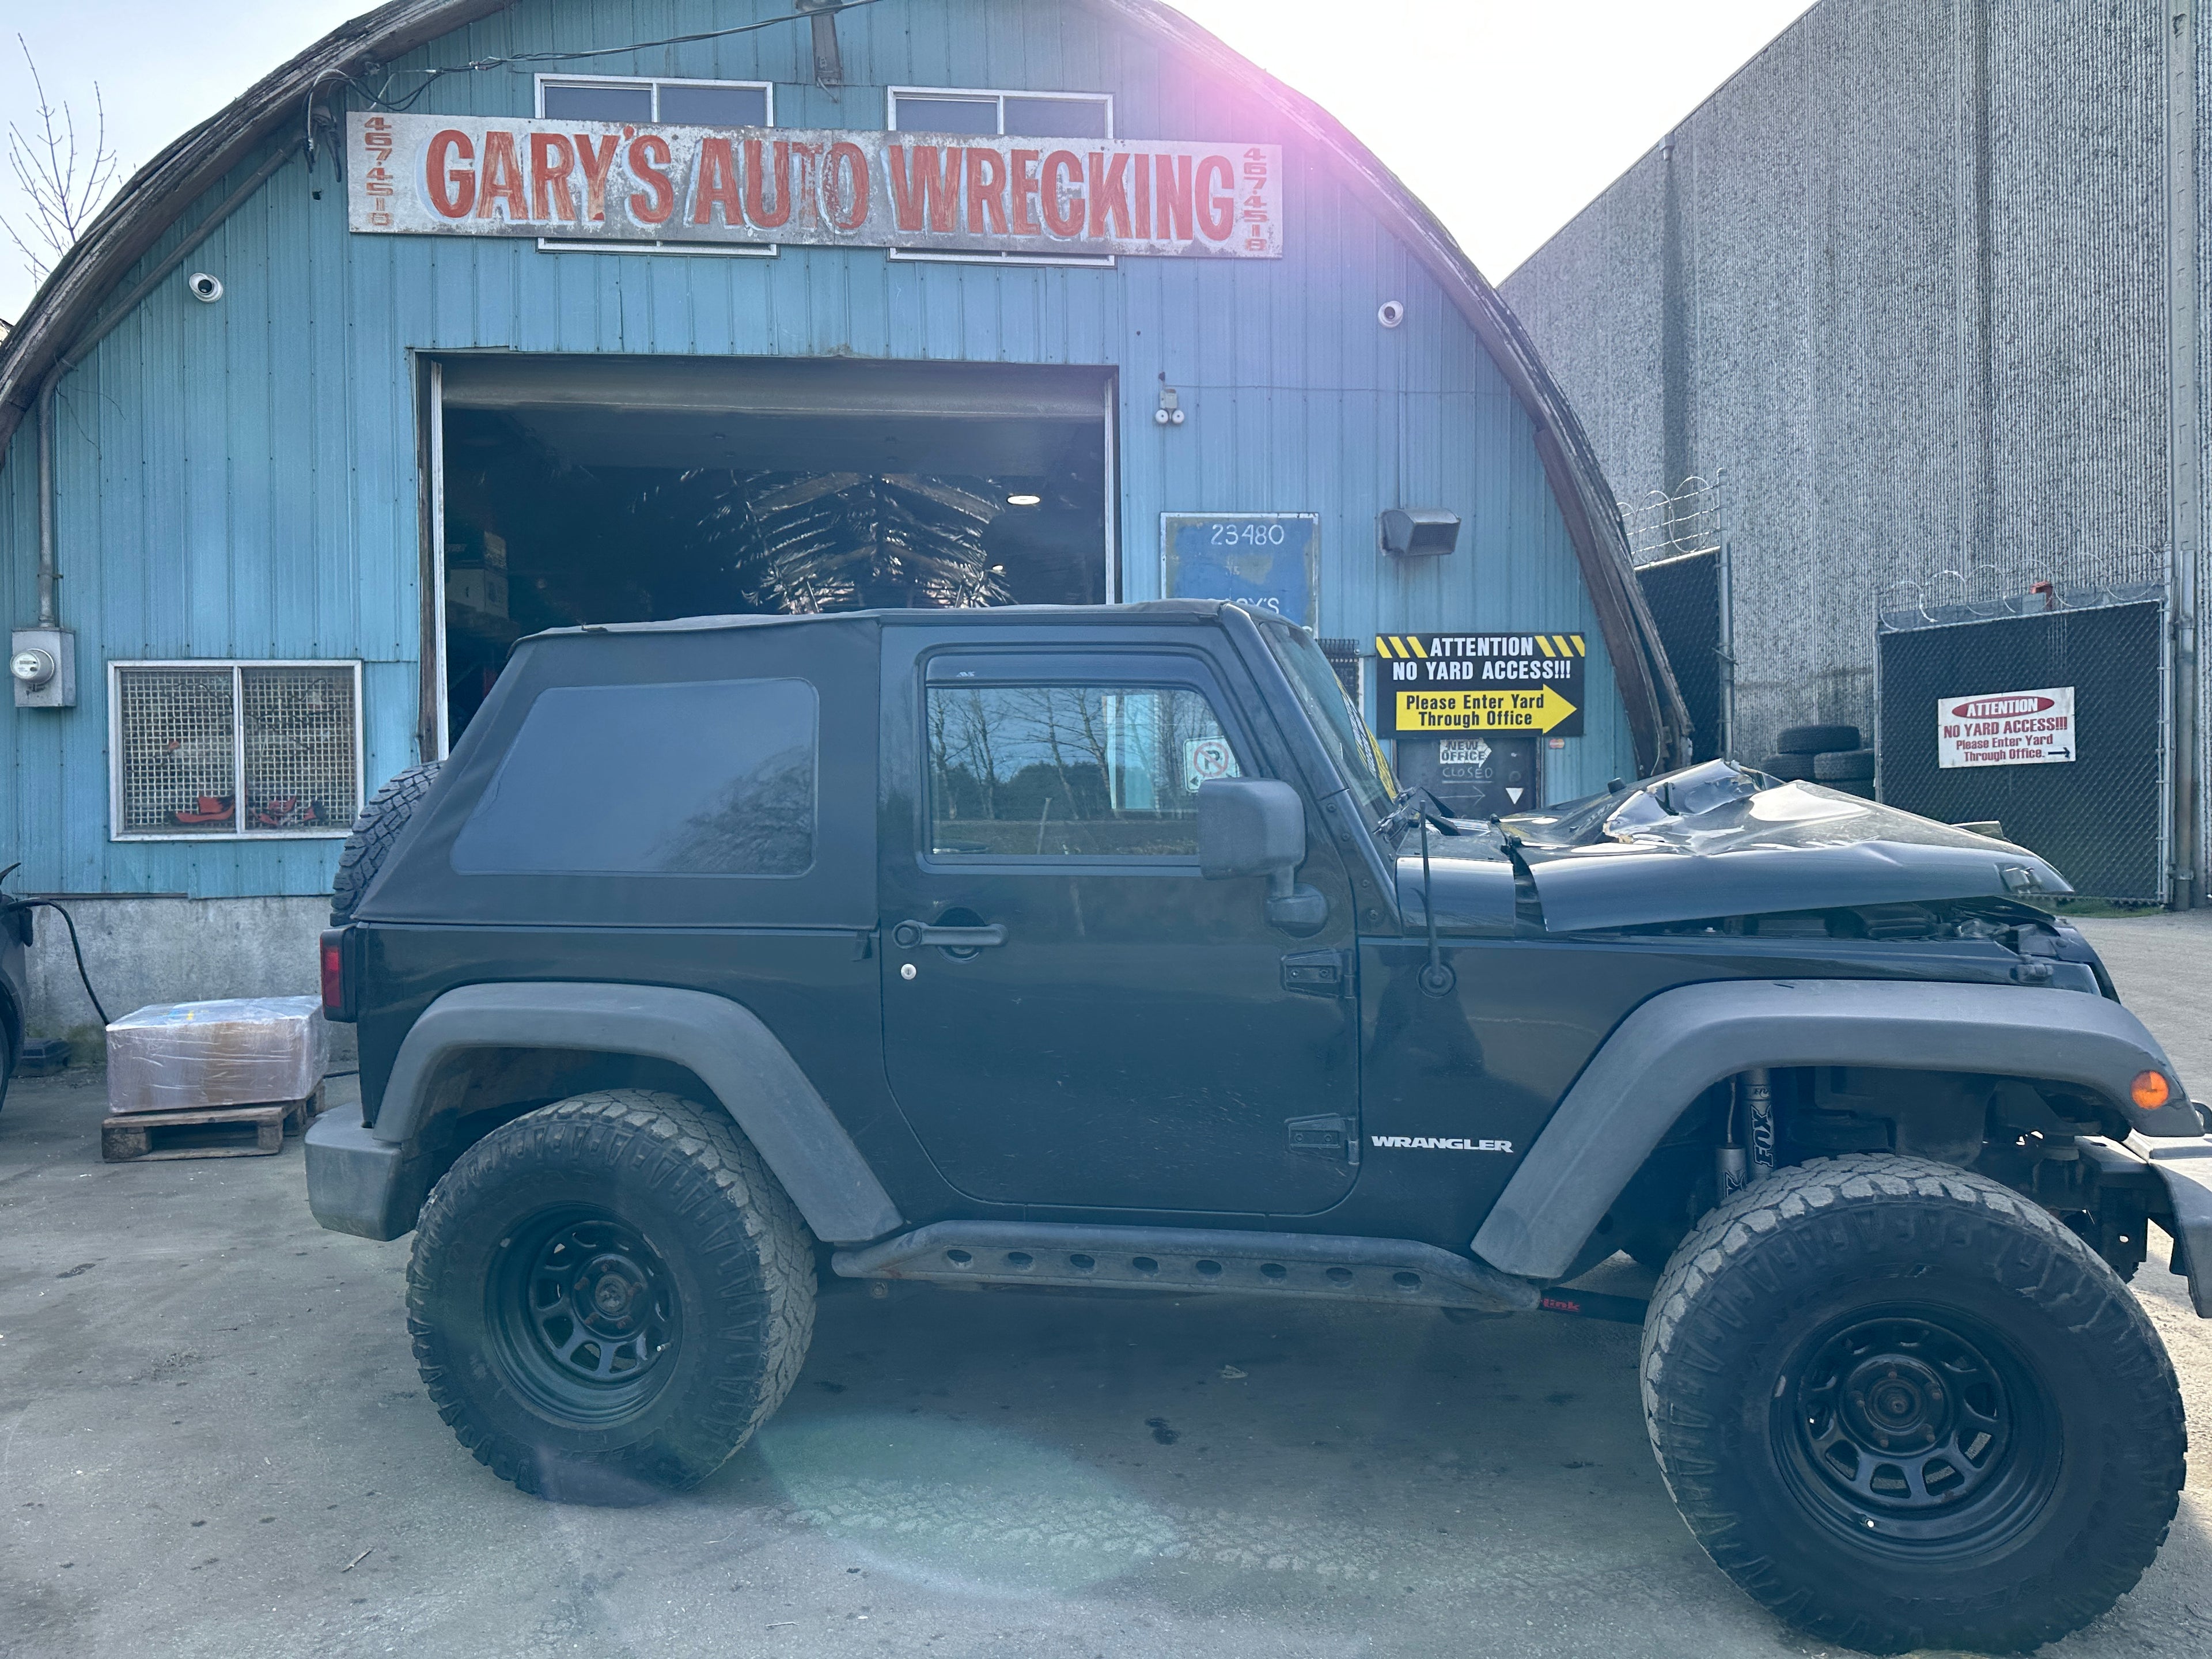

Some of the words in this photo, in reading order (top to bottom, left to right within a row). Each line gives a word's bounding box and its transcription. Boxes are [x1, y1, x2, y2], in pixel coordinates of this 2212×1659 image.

[426, 126, 673, 224] GARY'S
[694, 138, 869, 229] AUTO
[889, 145, 1234, 241] WRECKING
[1211, 524, 1285, 545] 23480
[1430, 637, 1533, 657] ATTENTION
[1393, 661, 1417, 680] NO
[1426, 661, 1474, 680] YARD
[1482, 660, 1571, 679] ACCESS!!!
[1406, 695, 1456, 710] Please
[1464, 695, 1503, 709] Enter
[1511, 694, 1544, 709] Yard
[1966, 698, 2038, 717] ATTENTION
[1418, 711, 1479, 728] Through
[1487, 710, 1532, 725] Office
[1944, 725, 1960, 738] NO
[1964, 722, 1999, 737] YARD
[2003, 716, 2067, 734] ACCESS!!!
[1446, 741, 1478, 750] NEW
[1956, 738, 1989, 750] Please
[1992, 737, 2022, 748] Enter
[2025, 734, 2053, 745] Yard
[1442, 751, 1486, 761] OFFICE
[1964, 749, 2006, 762] Through
[2009, 748, 2044, 760] Office.
[1442, 767, 1493, 779] CLOSED
[1371, 1135, 1513, 1153] WRANGLER
[1751, 1104, 1774, 1168] FOX
